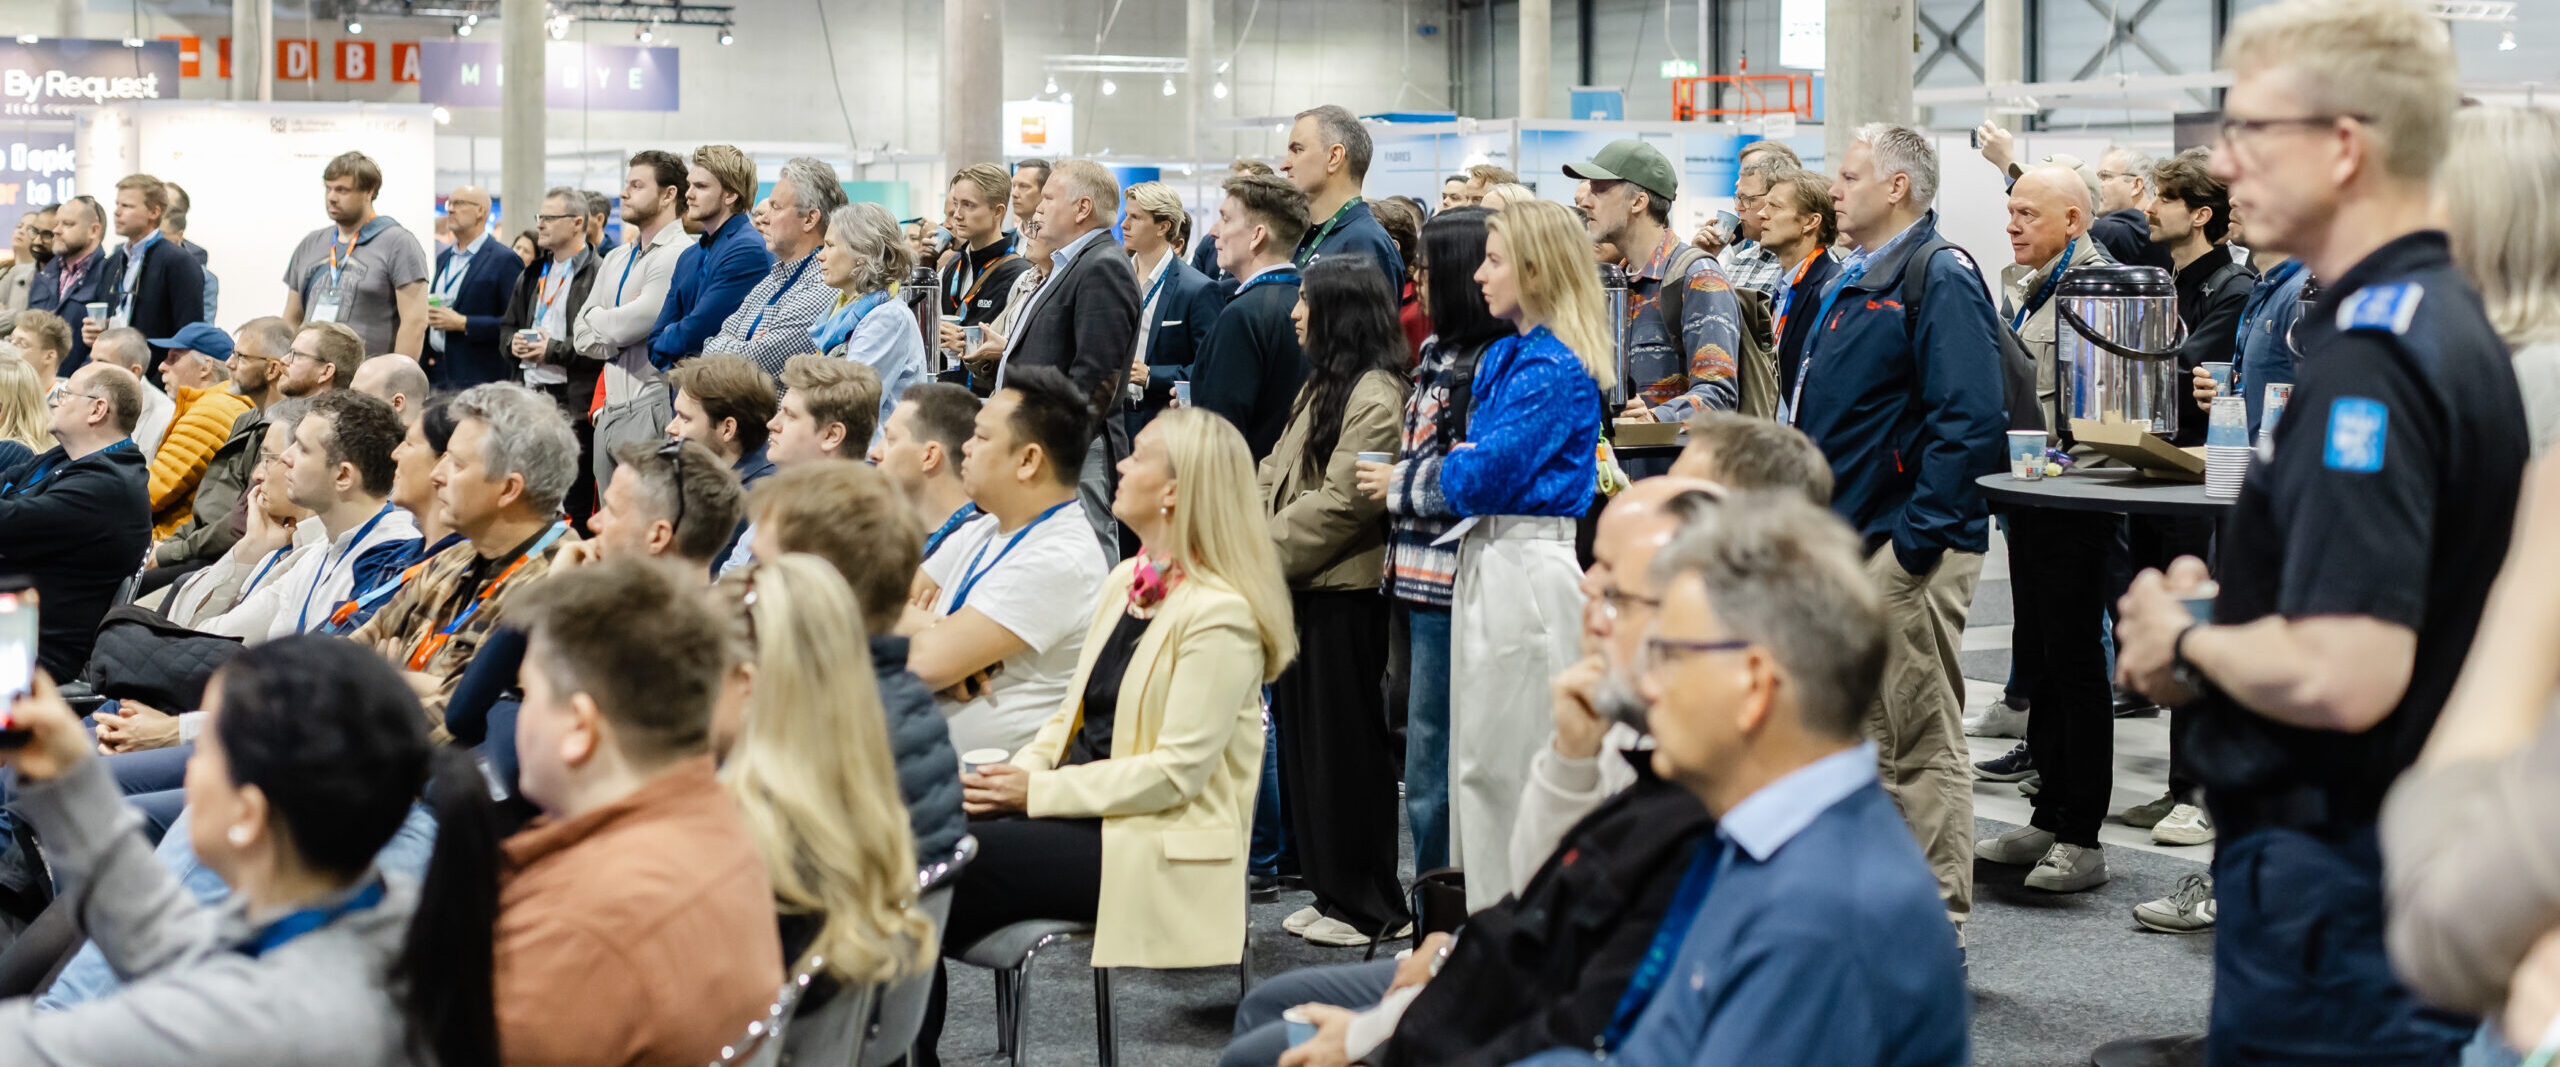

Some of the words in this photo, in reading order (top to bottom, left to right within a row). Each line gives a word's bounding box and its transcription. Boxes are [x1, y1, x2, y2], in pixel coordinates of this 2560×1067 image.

[4, 69, 44, 103] By
[45, 70, 159, 104] Request
[26, 178, 52, 206] to
